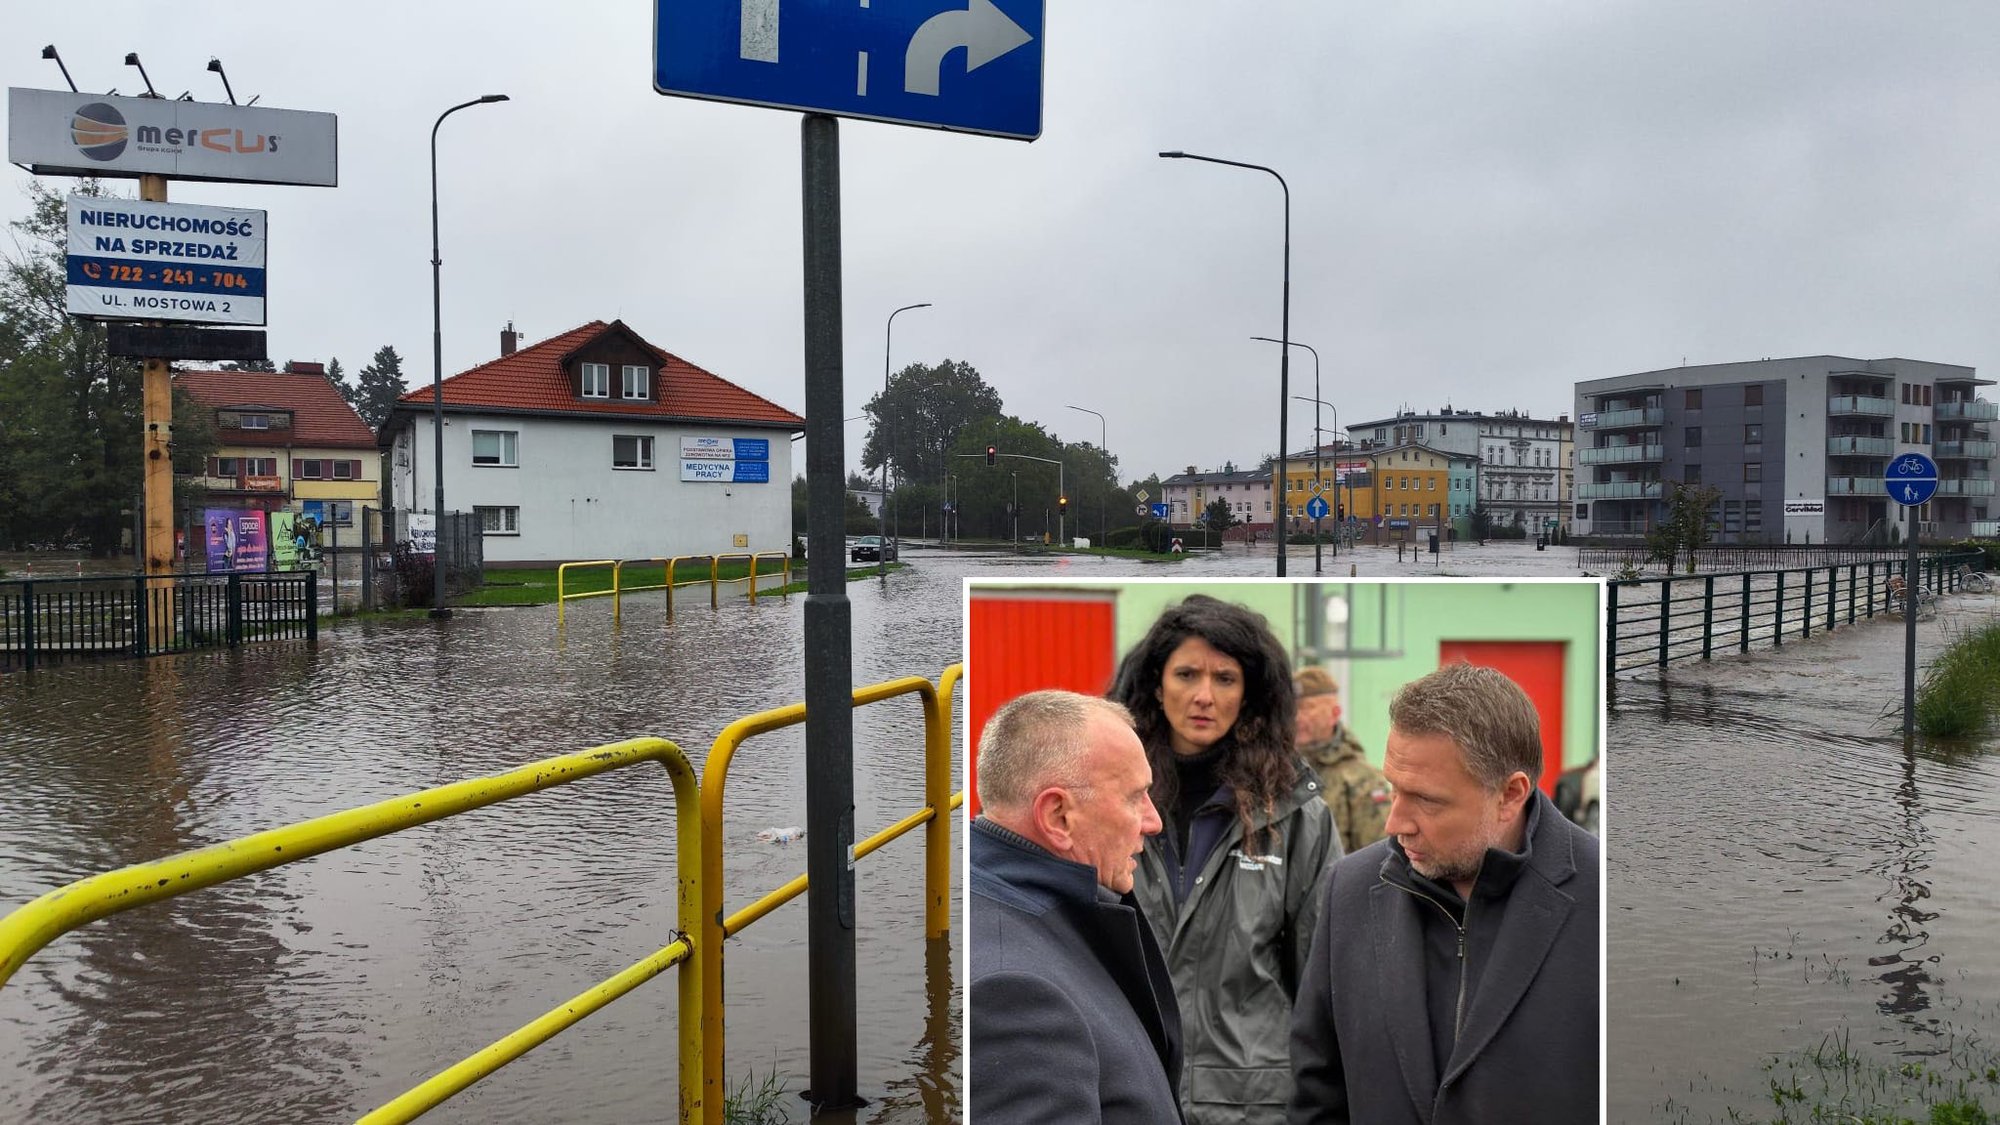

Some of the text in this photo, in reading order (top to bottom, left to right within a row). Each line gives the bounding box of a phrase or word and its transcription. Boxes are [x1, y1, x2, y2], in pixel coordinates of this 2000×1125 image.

[137, 125, 279, 154] mercus
[80, 210, 253, 237] NIERUCHOMOŚĆ
[95, 236, 238, 260] NA SPRZEDAŻ
[109, 265, 142, 282] 722
[163, 267, 194, 285] 241
[213, 271, 248, 289] 704
[102, 294, 232, 313] UL. MOSTOWA 2
[686, 463, 730, 471] MEDYCYNA
[695, 471, 723, 479] PRACY
[241, 521, 259, 531] space
